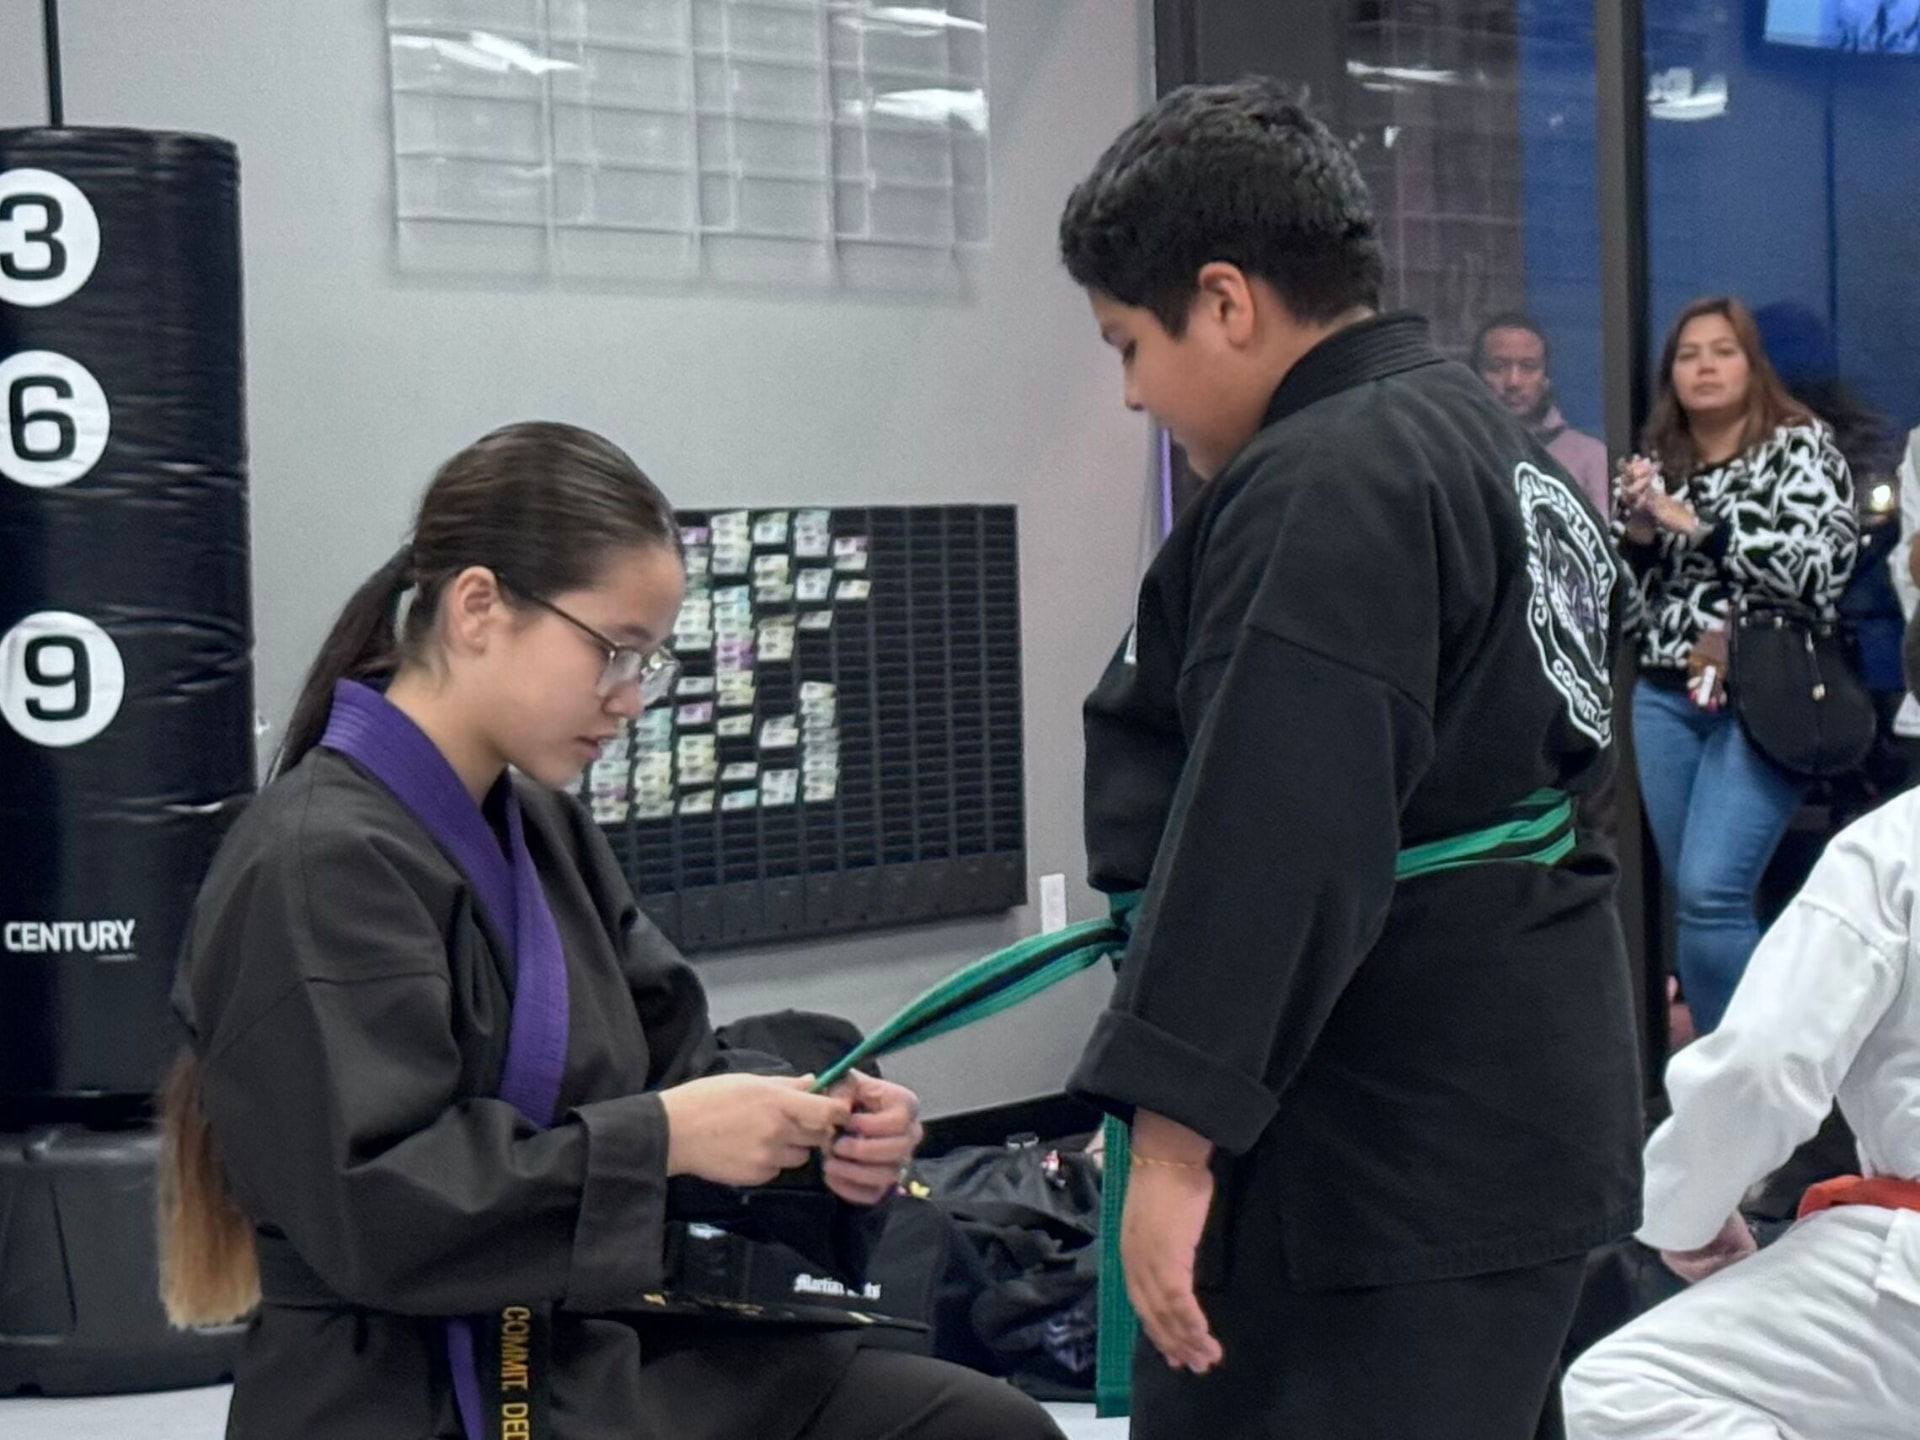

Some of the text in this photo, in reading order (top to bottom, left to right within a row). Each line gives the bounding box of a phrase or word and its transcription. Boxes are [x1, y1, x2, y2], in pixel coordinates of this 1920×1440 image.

[0, 192, 67, 281] 3
[9, 375, 77, 462] 6
[24, 634, 91, 721] 9
[4, 918, 136, 952] CENTURY
